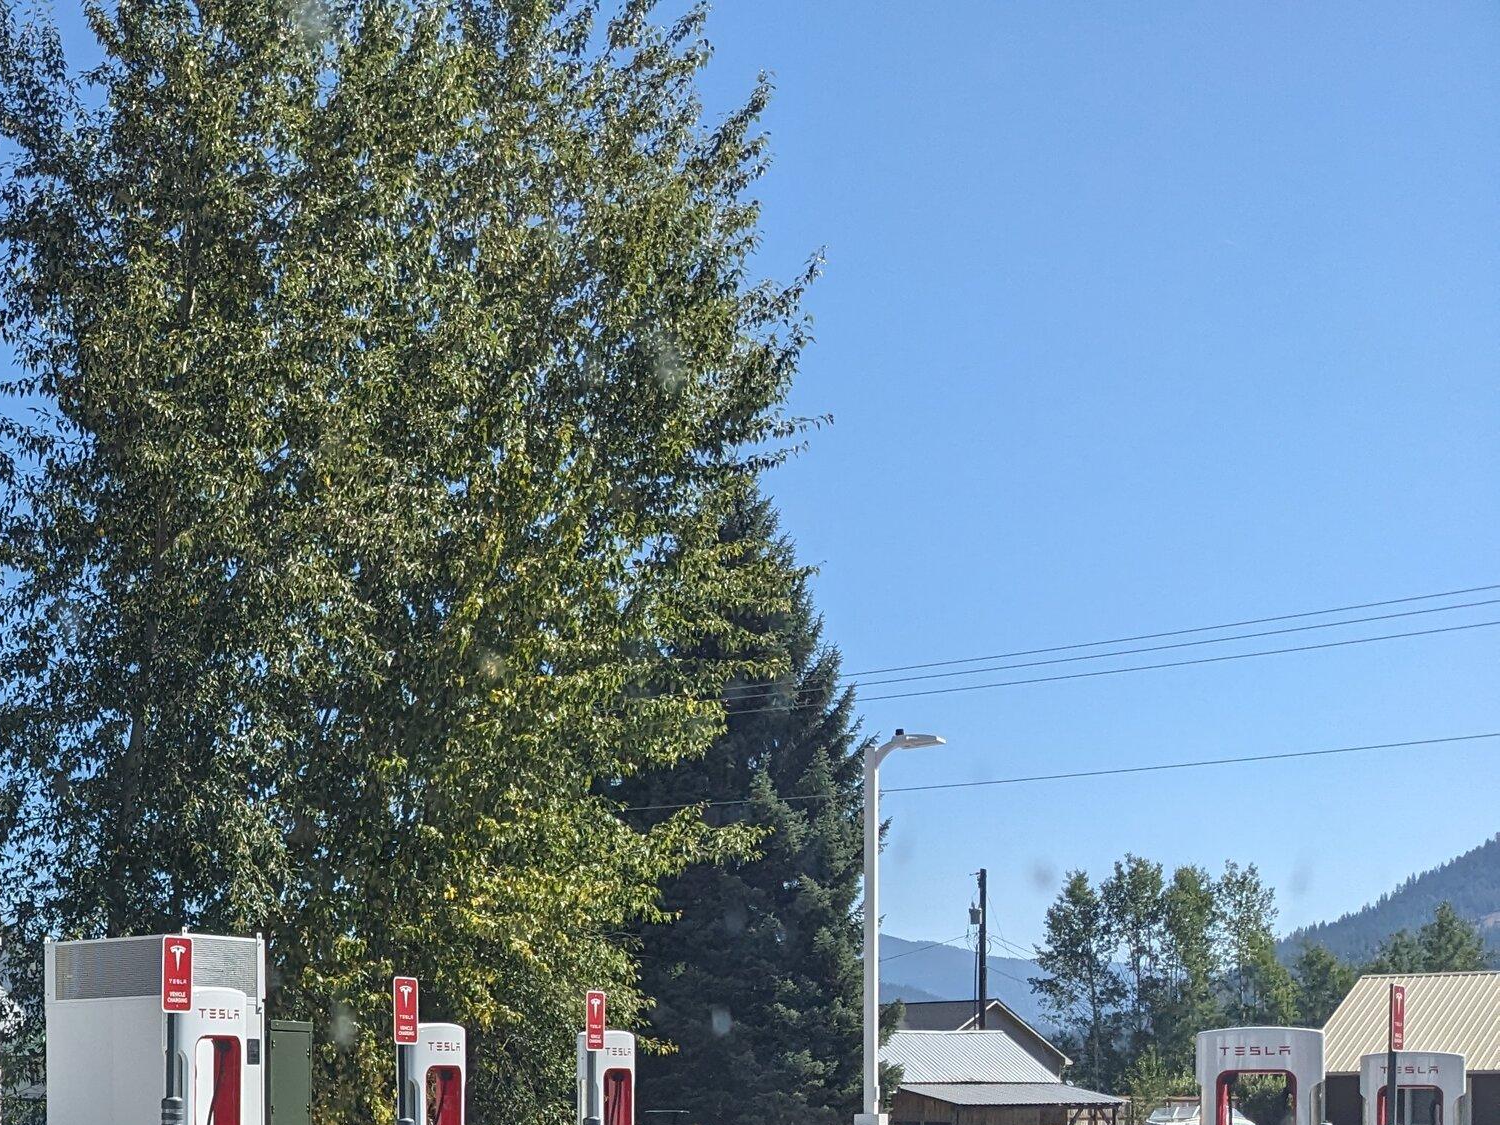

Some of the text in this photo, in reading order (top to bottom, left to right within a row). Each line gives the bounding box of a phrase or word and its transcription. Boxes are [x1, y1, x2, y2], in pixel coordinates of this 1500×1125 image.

[198, 1008, 240, 1019] TESLA
[428, 1041, 461, 1052] TESLA
[605, 1047, 632, 1056] TESLA
[1219, 1045, 1291, 1056] TESLA
